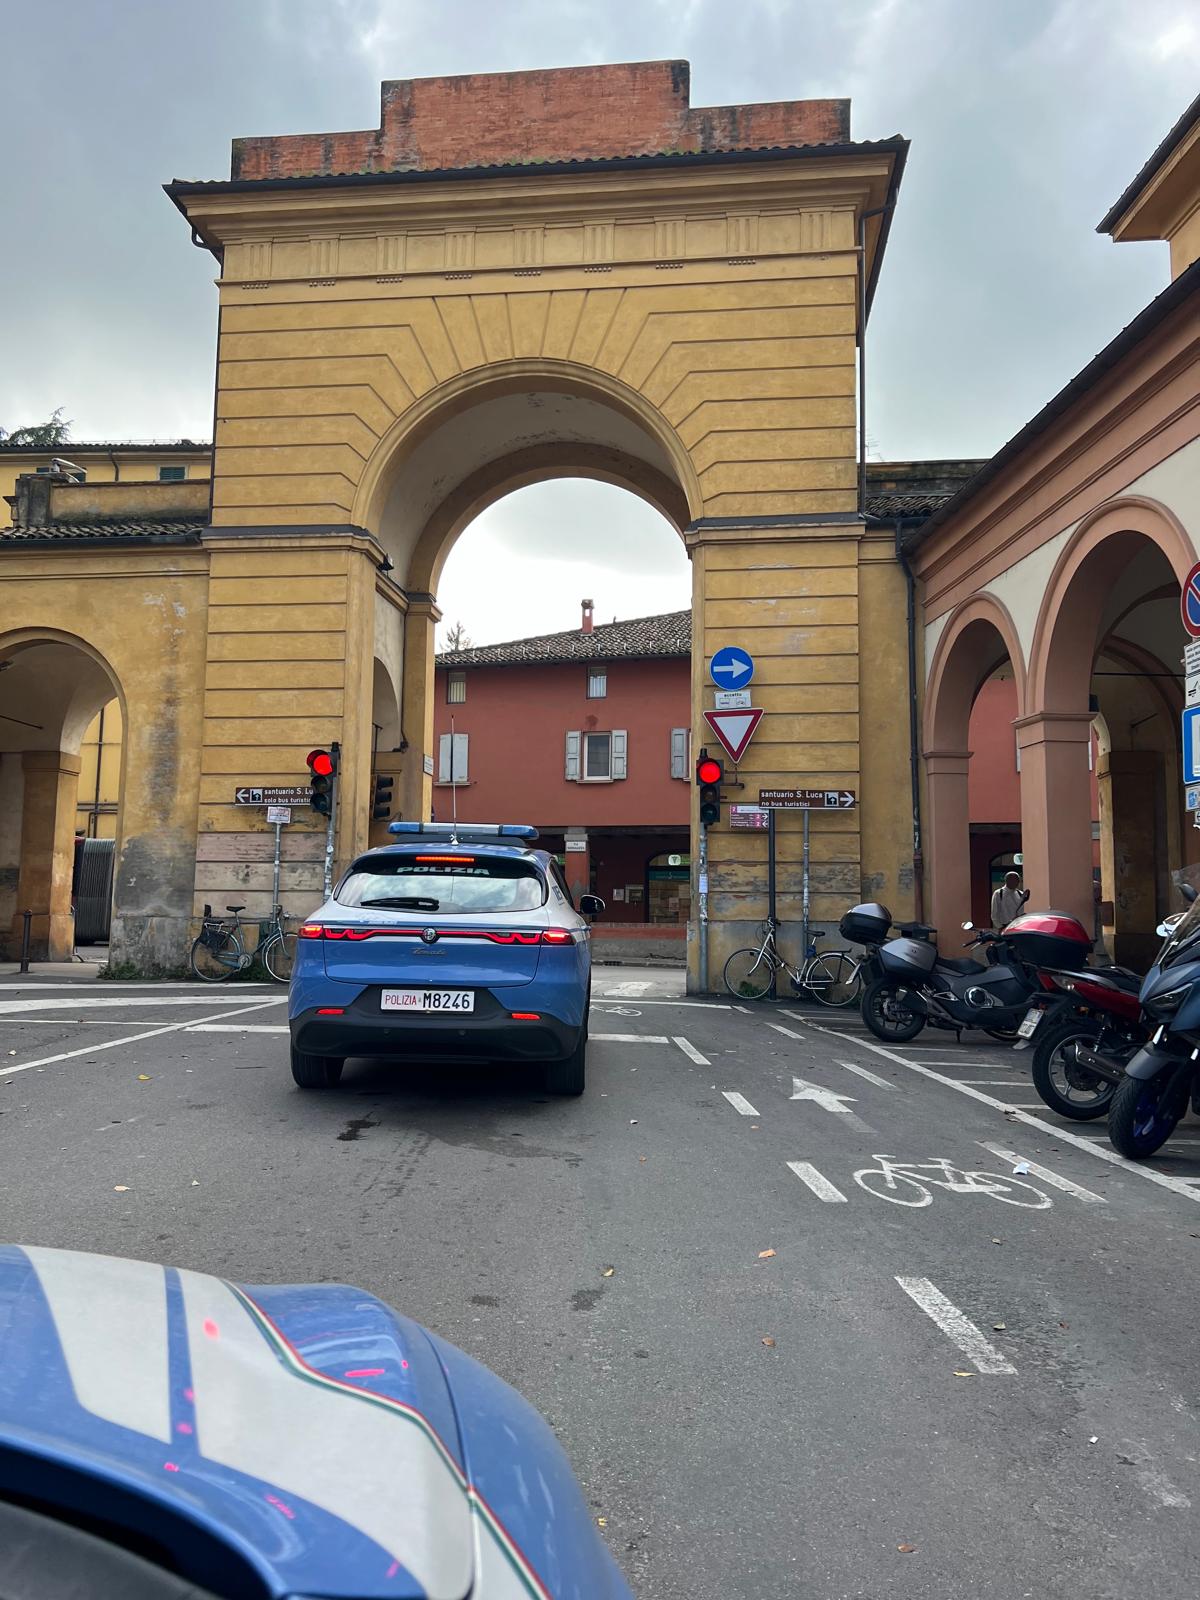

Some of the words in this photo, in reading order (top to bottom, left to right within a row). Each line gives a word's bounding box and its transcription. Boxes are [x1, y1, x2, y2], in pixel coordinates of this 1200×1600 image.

[296, 787, 303, 795] S.
[305, 787, 314, 795] Lu
[796, 790, 804, 798] S.
[805, 790, 823, 798] Luca
[396, 866, 490, 875] POLIZIA
[385, 994, 417, 1006] POLIZIA
[422, 992, 470, 1009] M8246
